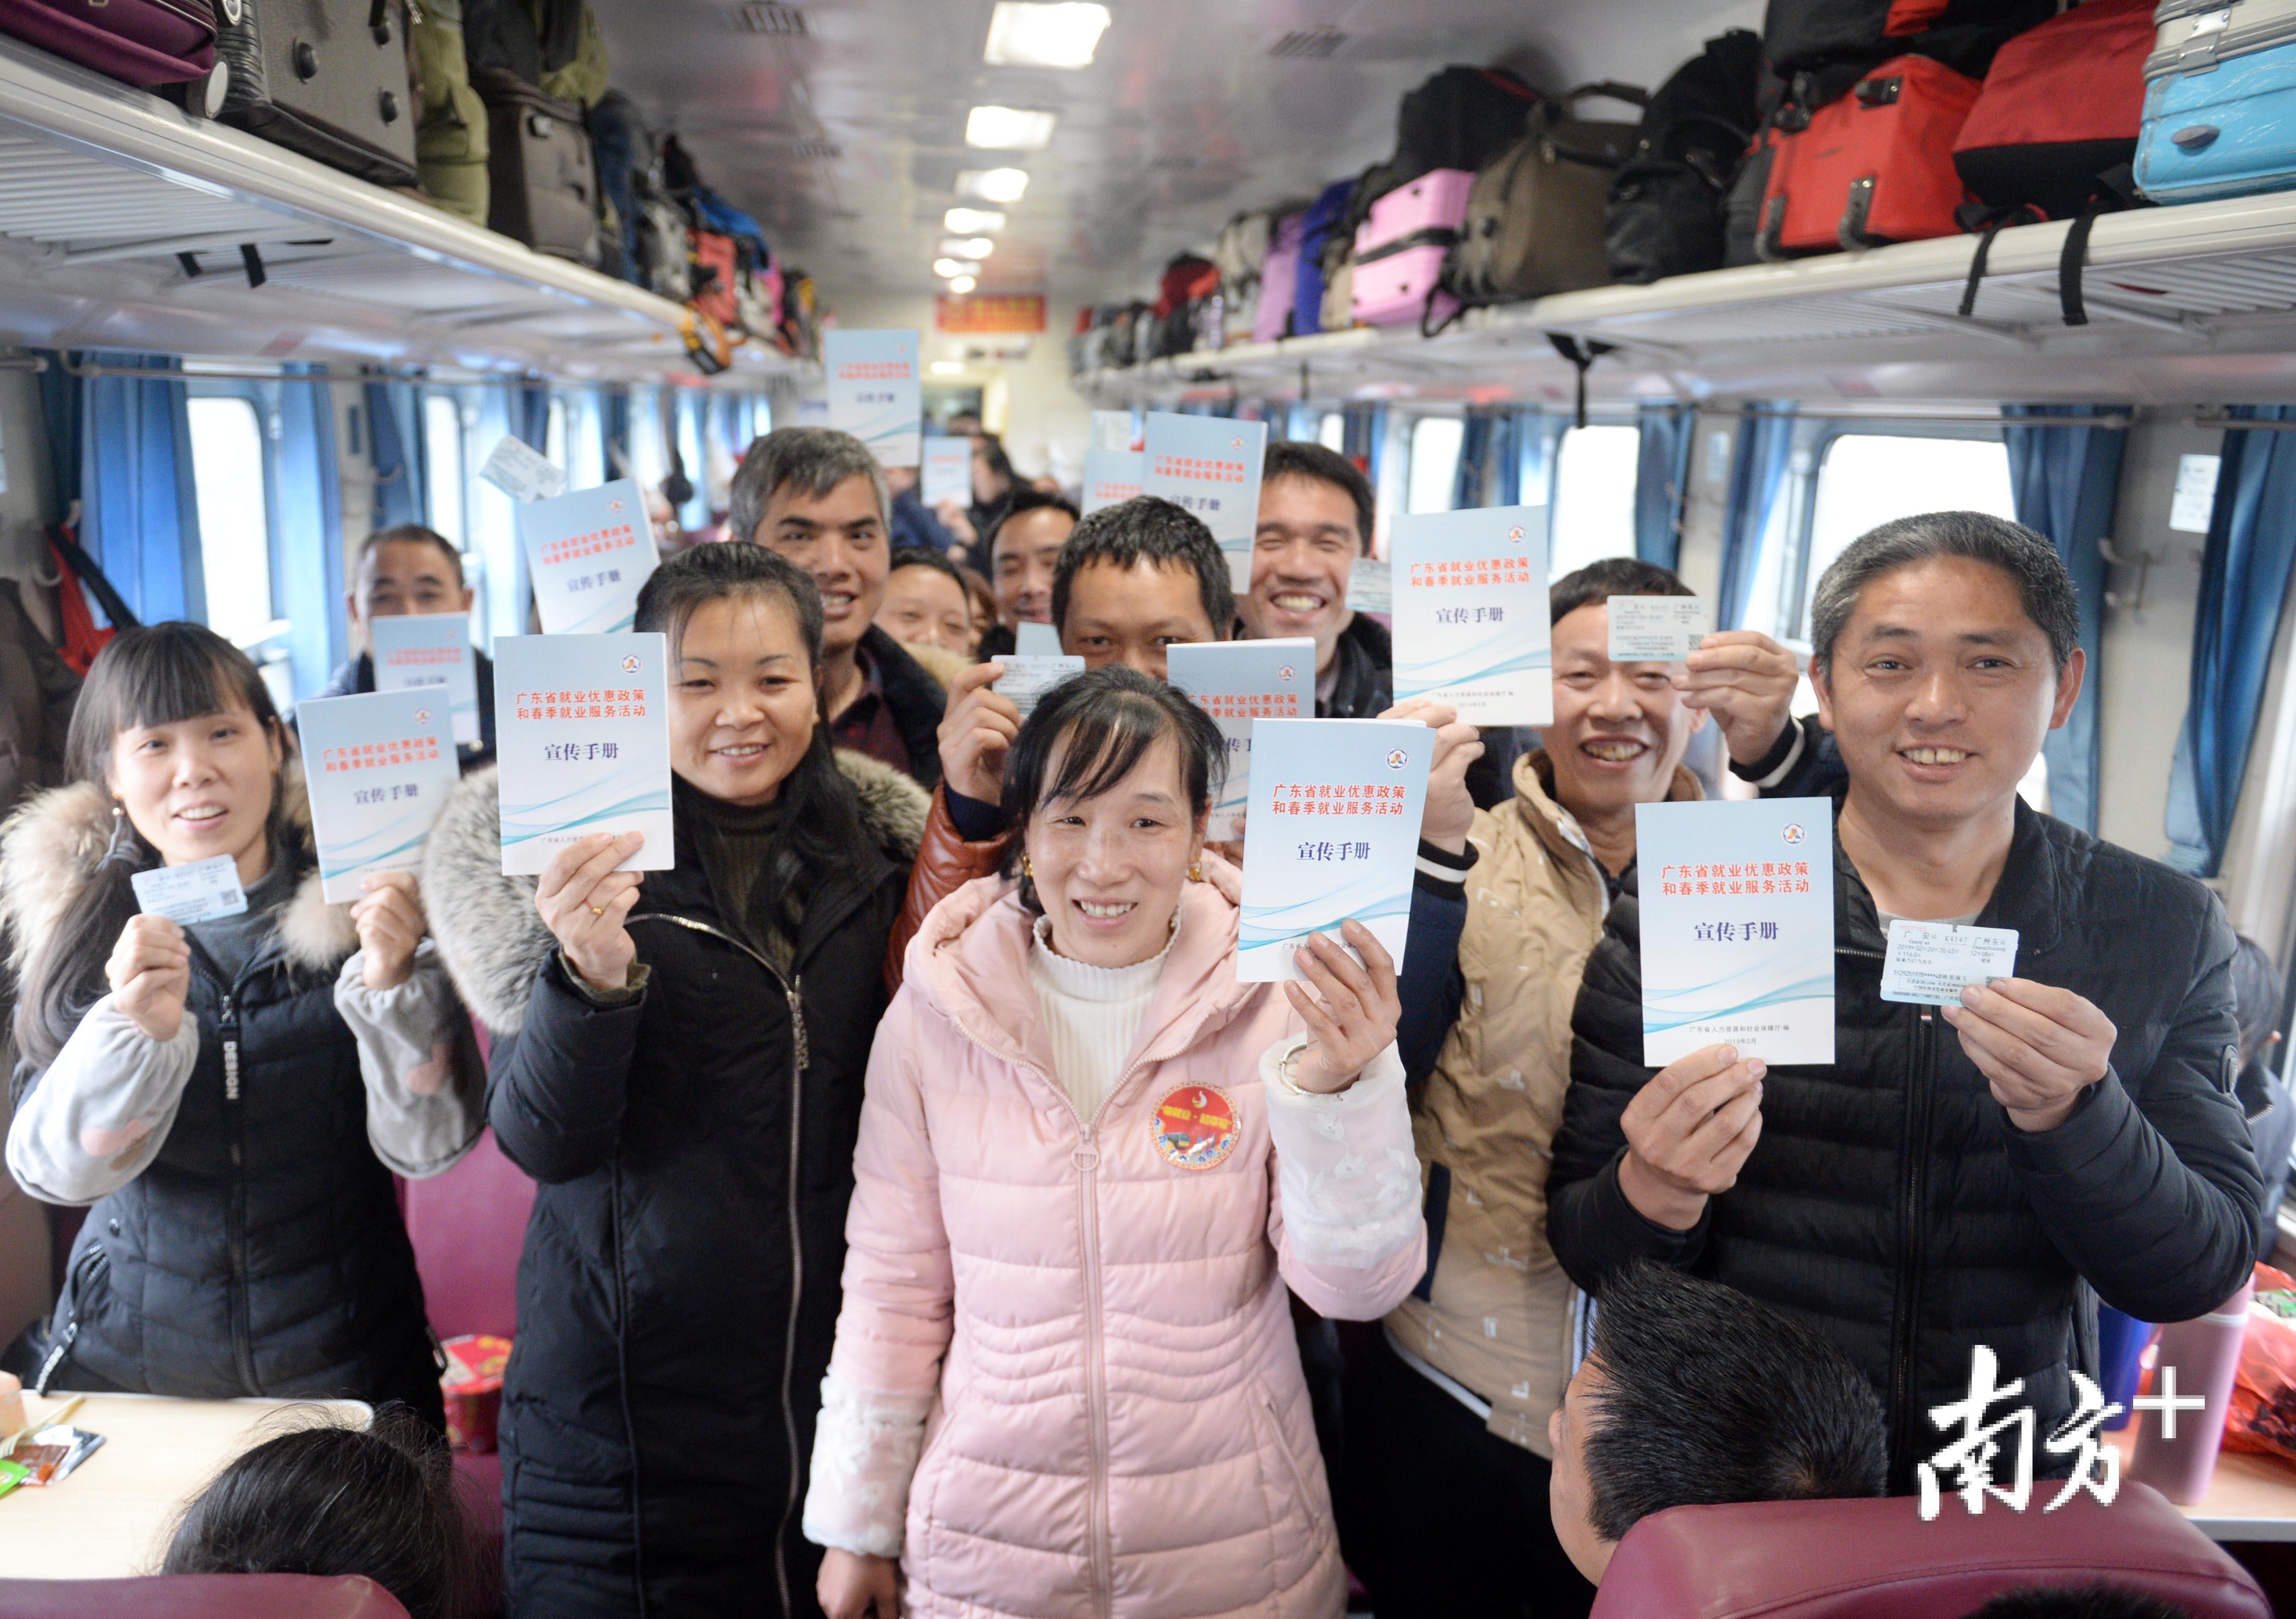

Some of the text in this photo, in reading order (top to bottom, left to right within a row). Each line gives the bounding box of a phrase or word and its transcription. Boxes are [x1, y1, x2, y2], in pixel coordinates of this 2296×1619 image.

[1411, 557, 1530, 574] 广东省就业优惠政策
[566, 570, 621, 593] 宣传手册
[1411, 572, 1530, 587] 和春季就业服务活动
[1436, 607, 1505, 624] 宣传手册
[516, 689, 645, 705] 广东省就业优惠政策
[517, 705, 646, 720] 和春季就业服务活动
[323, 736, 438, 761] 广东省就业优惠政策
[544, 742, 619, 761] 宣传手册
[325, 749, 440, 772] 和春季就业服务活动
[354, 783, 419, 804] 宣传手册
[1273, 784, 1405, 799] 广东省就业优惠政策
[1272, 801, 1403, 815] 和春季就业服务活动
[1297, 841, 1371, 861] 宣传手册
[1662, 861, 1809, 879] 广东省就业优惠政策
[1662, 879, 1809, 895] 和春季就业服务活动
[1694, 922, 1779, 942] 宣传手册
[1689, 1024, 1781, 1033] 广东省人力资源和社会保障厅
